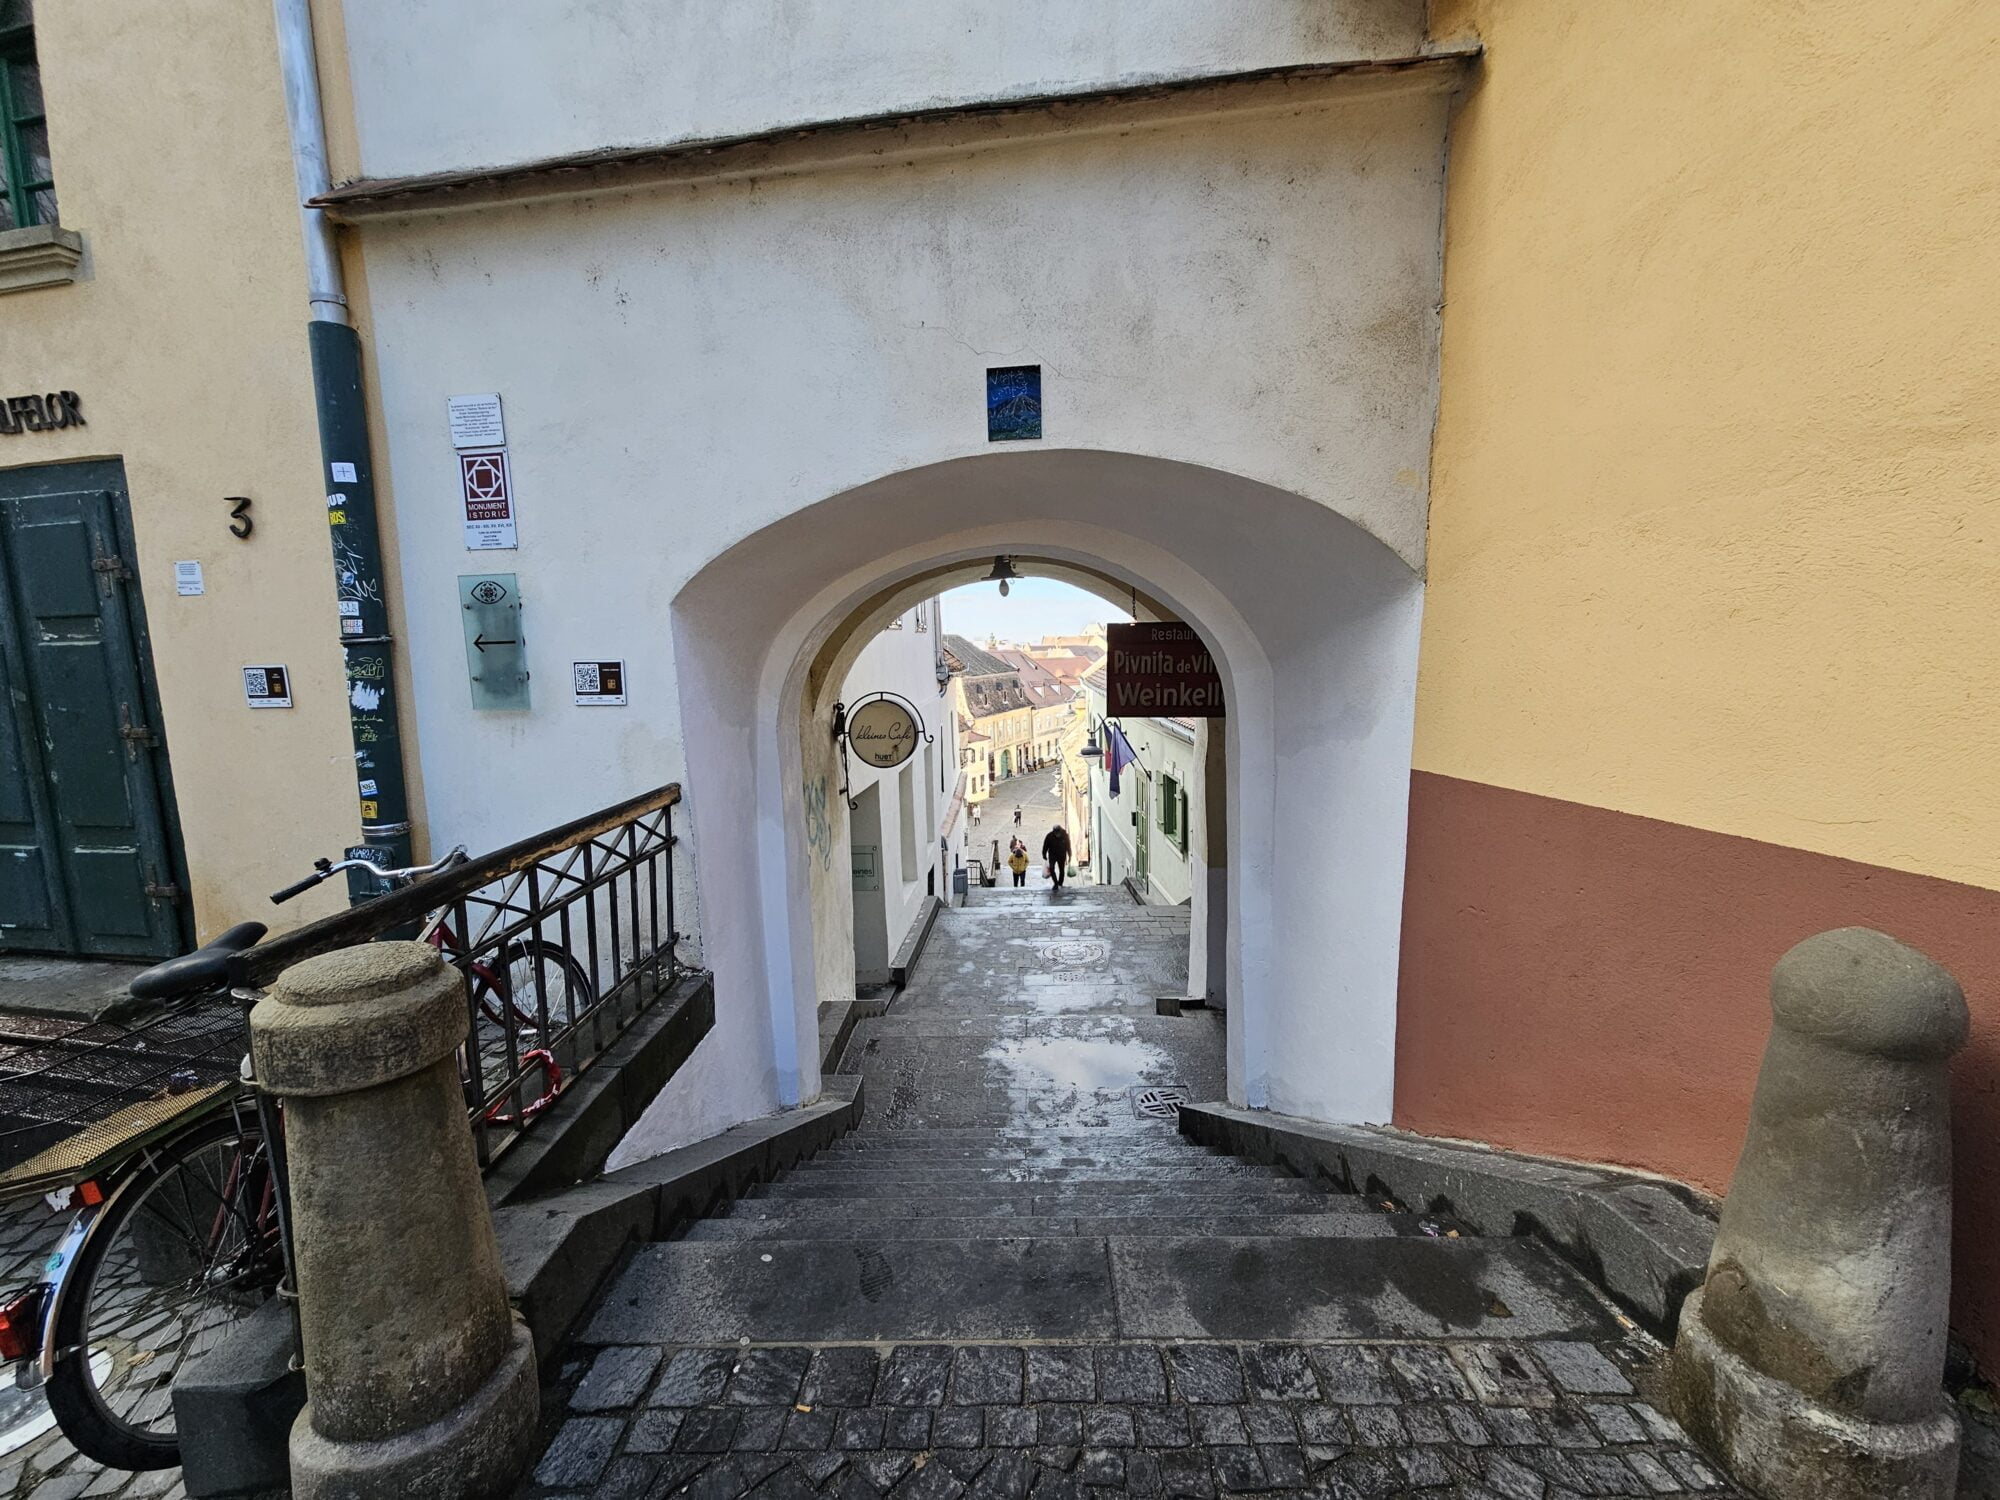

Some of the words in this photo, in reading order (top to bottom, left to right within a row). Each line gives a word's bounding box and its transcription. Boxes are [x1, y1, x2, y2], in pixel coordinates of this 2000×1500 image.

[467, 502, 506, 511] MONUMENT
[468, 511, 508, 519] ISTORIC
[224, 496, 253, 538] 3
[1151, 628, 1199, 640] Restaur
[1114, 650, 1174, 676] Pivnița
[1176, 659, 1191, 674] de
[1116, 681, 1225, 706] Weinkell
